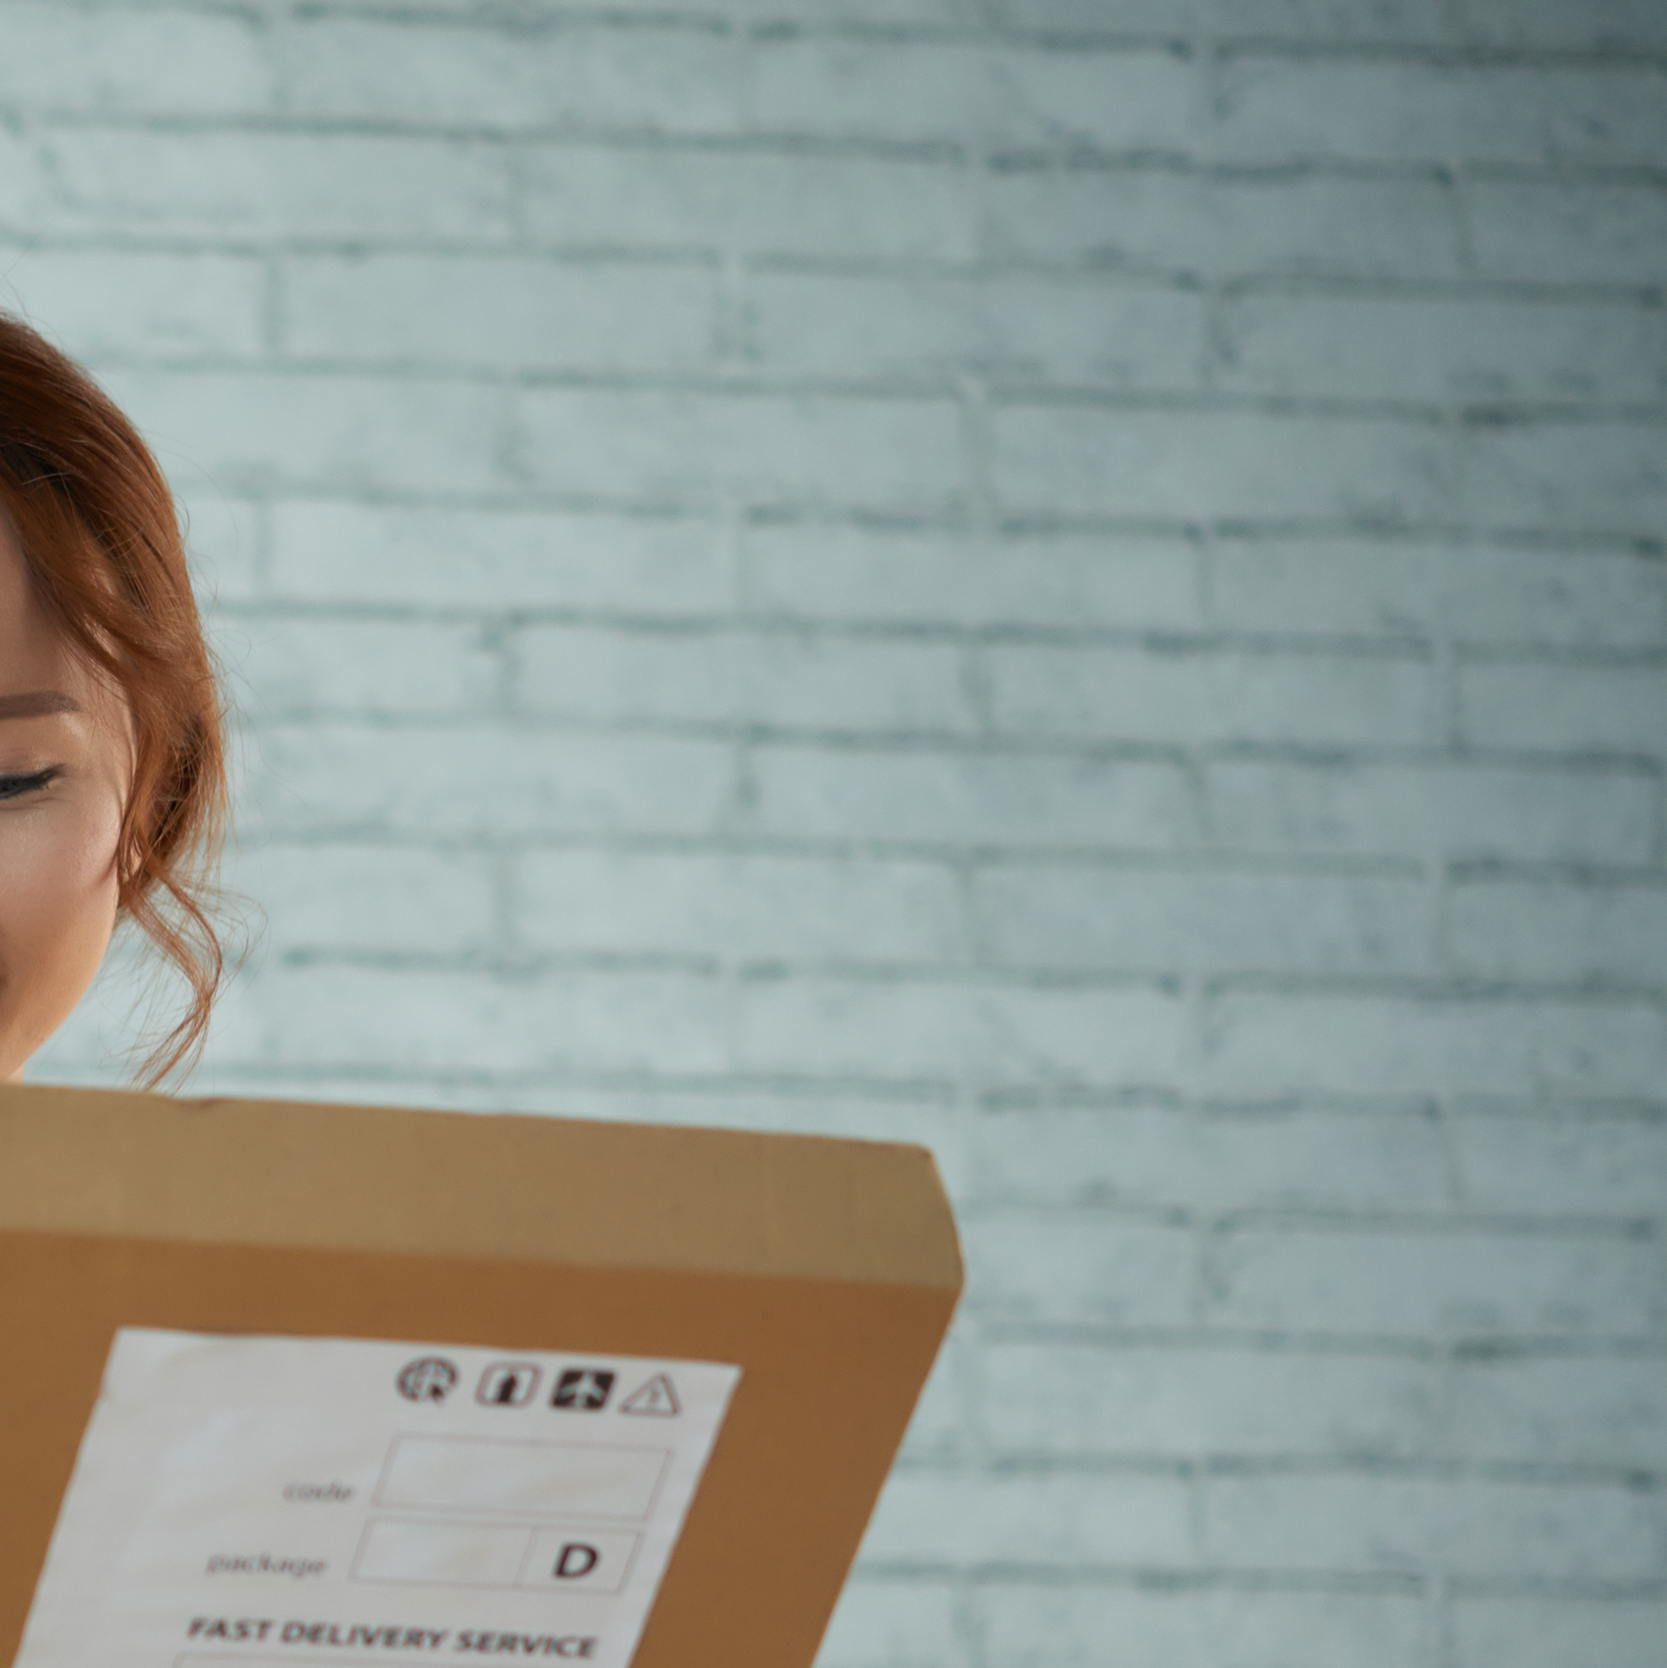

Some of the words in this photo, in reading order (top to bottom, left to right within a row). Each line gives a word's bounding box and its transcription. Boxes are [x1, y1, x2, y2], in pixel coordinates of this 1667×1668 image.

[283, 1481, 355, 1503] code
[205, 1552, 328, 1578] package
[553, 1541, 599, 1579] D
[187, 1616, 275, 1640] FAST
[281, 1619, 448, 1650] DELIVERY
[453, 1629, 599, 1659] SERVICE
